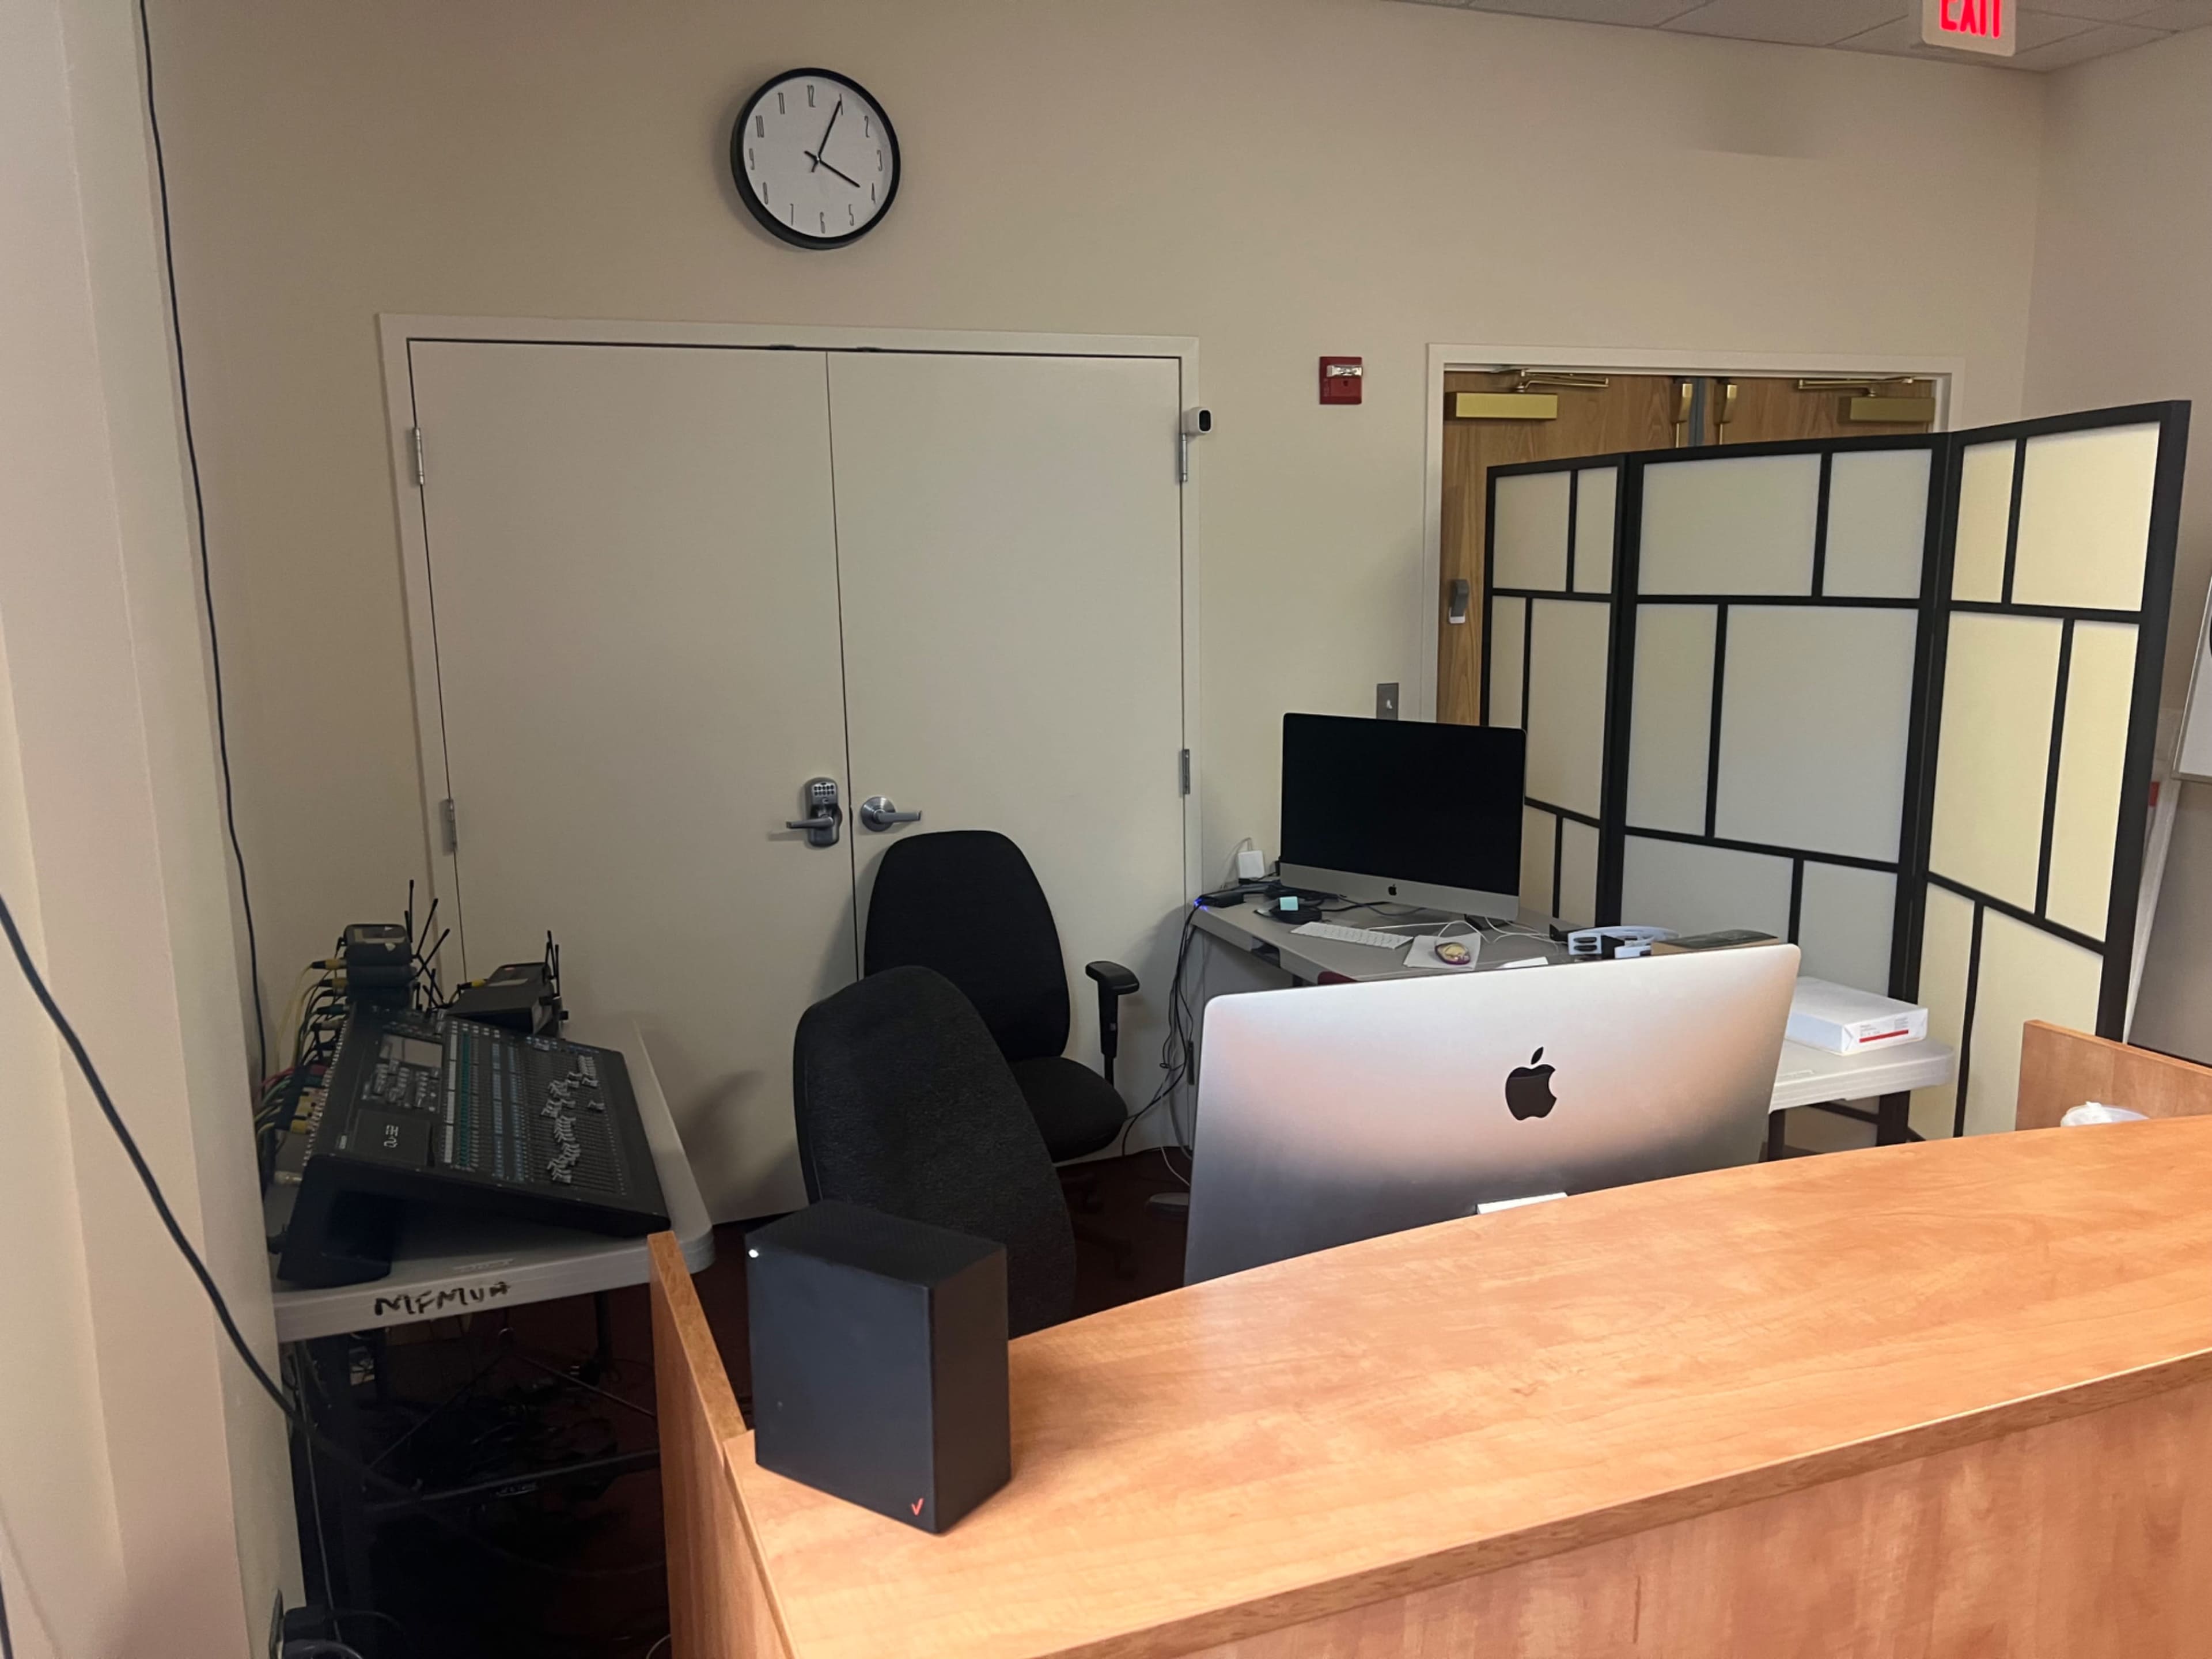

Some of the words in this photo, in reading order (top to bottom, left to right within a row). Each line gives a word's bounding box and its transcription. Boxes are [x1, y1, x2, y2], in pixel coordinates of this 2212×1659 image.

[778, 92, 785, 115] 11
[806, 85, 816, 108] 12
[755, 115, 764, 138] 10
[864, 115, 870, 138] 2
[748, 148, 755, 171] 9
[877, 150, 883, 172] 3
[762, 181, 769, 205] 8
[871, 182, 876, 204] 4
[790, 203, 794, 226] 7
[820, 211, 825, 234] 6
[848, 204, 854, 226] 5
